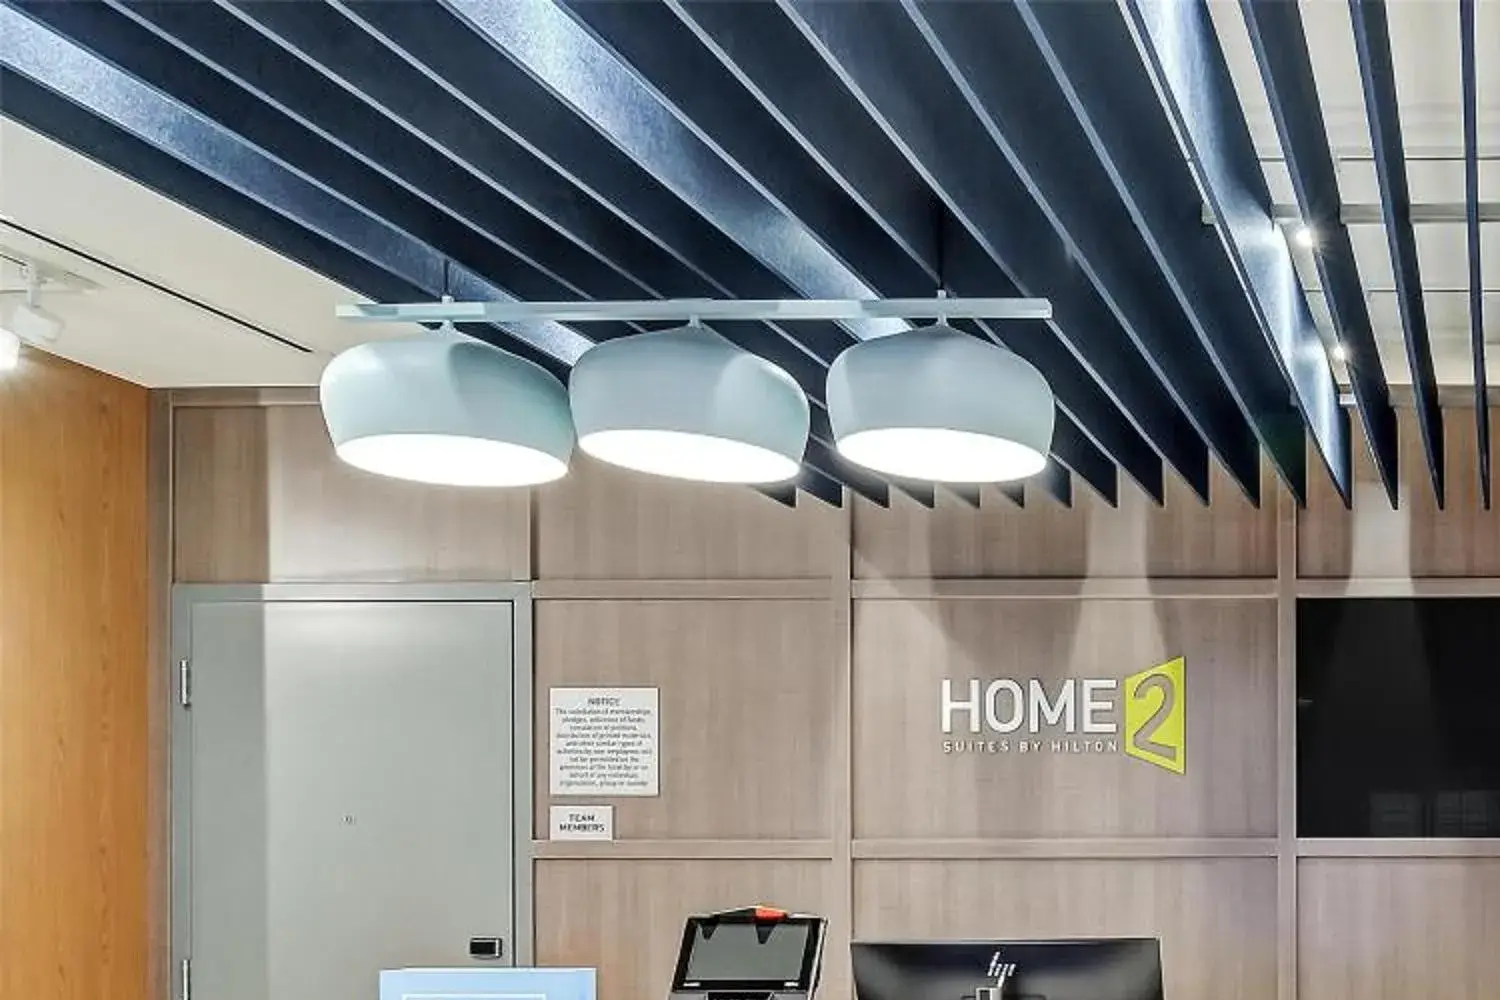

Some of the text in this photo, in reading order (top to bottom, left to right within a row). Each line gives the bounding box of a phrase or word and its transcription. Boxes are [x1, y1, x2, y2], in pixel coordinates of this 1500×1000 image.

[941, 668, 1180, 766] HOME 2
[942, 740, 1119, 753] SUITES BY HILTON
[568, 813, 595, 822] TEAM
[559, 823, 606, 833] MEMBERS
